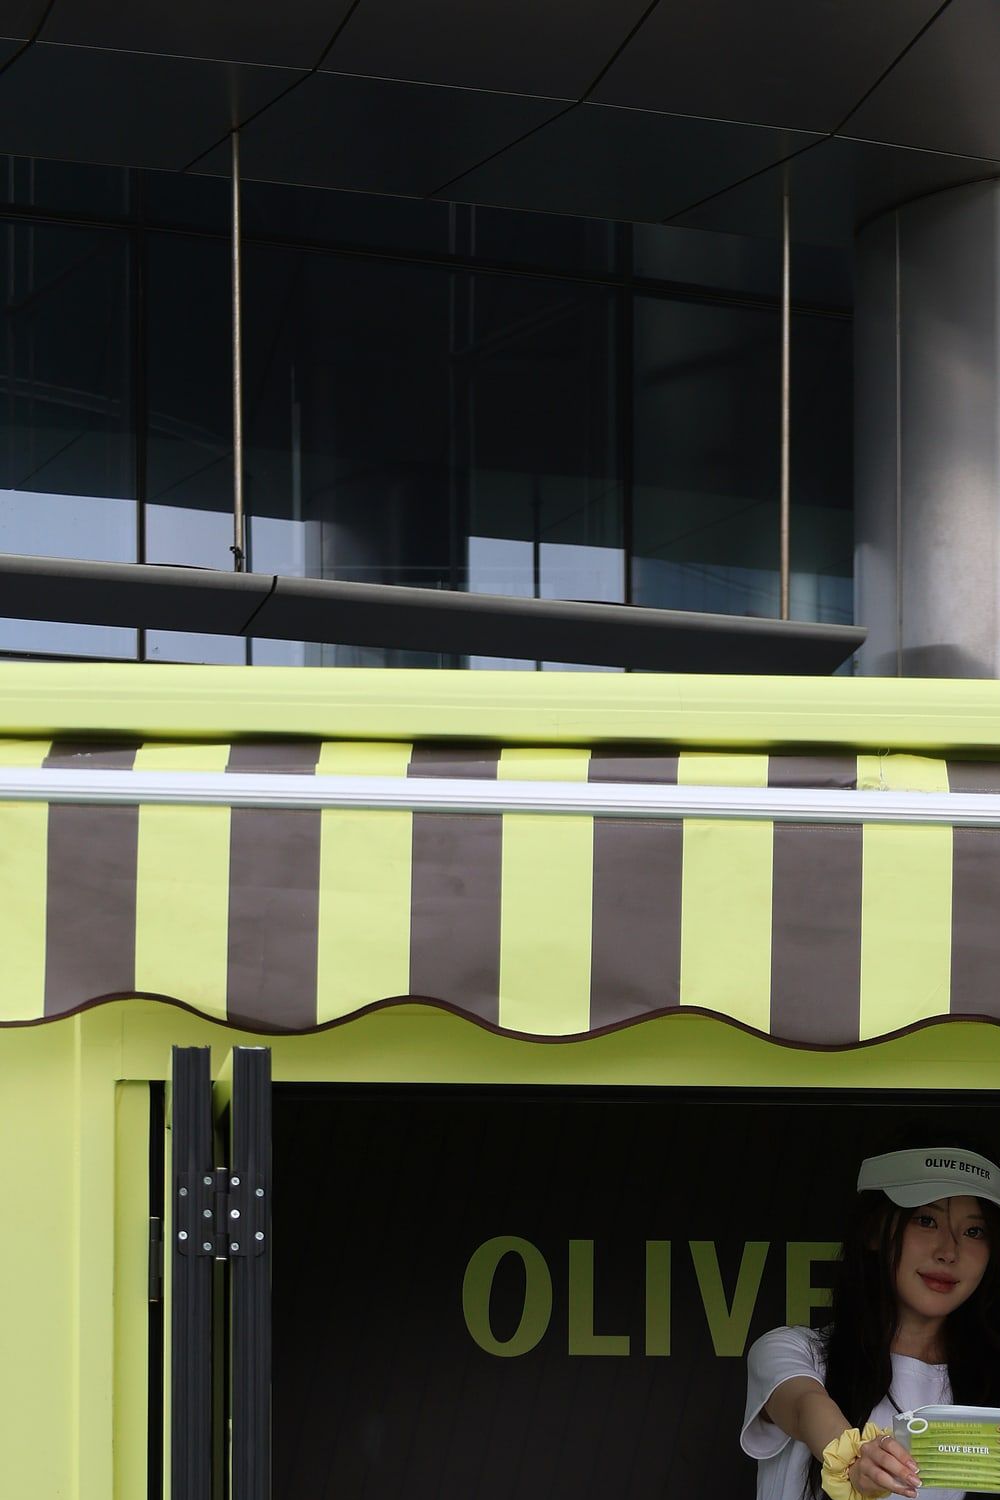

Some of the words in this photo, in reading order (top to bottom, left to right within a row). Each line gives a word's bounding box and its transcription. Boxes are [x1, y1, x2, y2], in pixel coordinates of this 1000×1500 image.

[925, 1158, 957, 1169] OLIVE
[959, 1162, 990, 1180] BETTER
[938, 1444, 961, 1453] OLIVE
